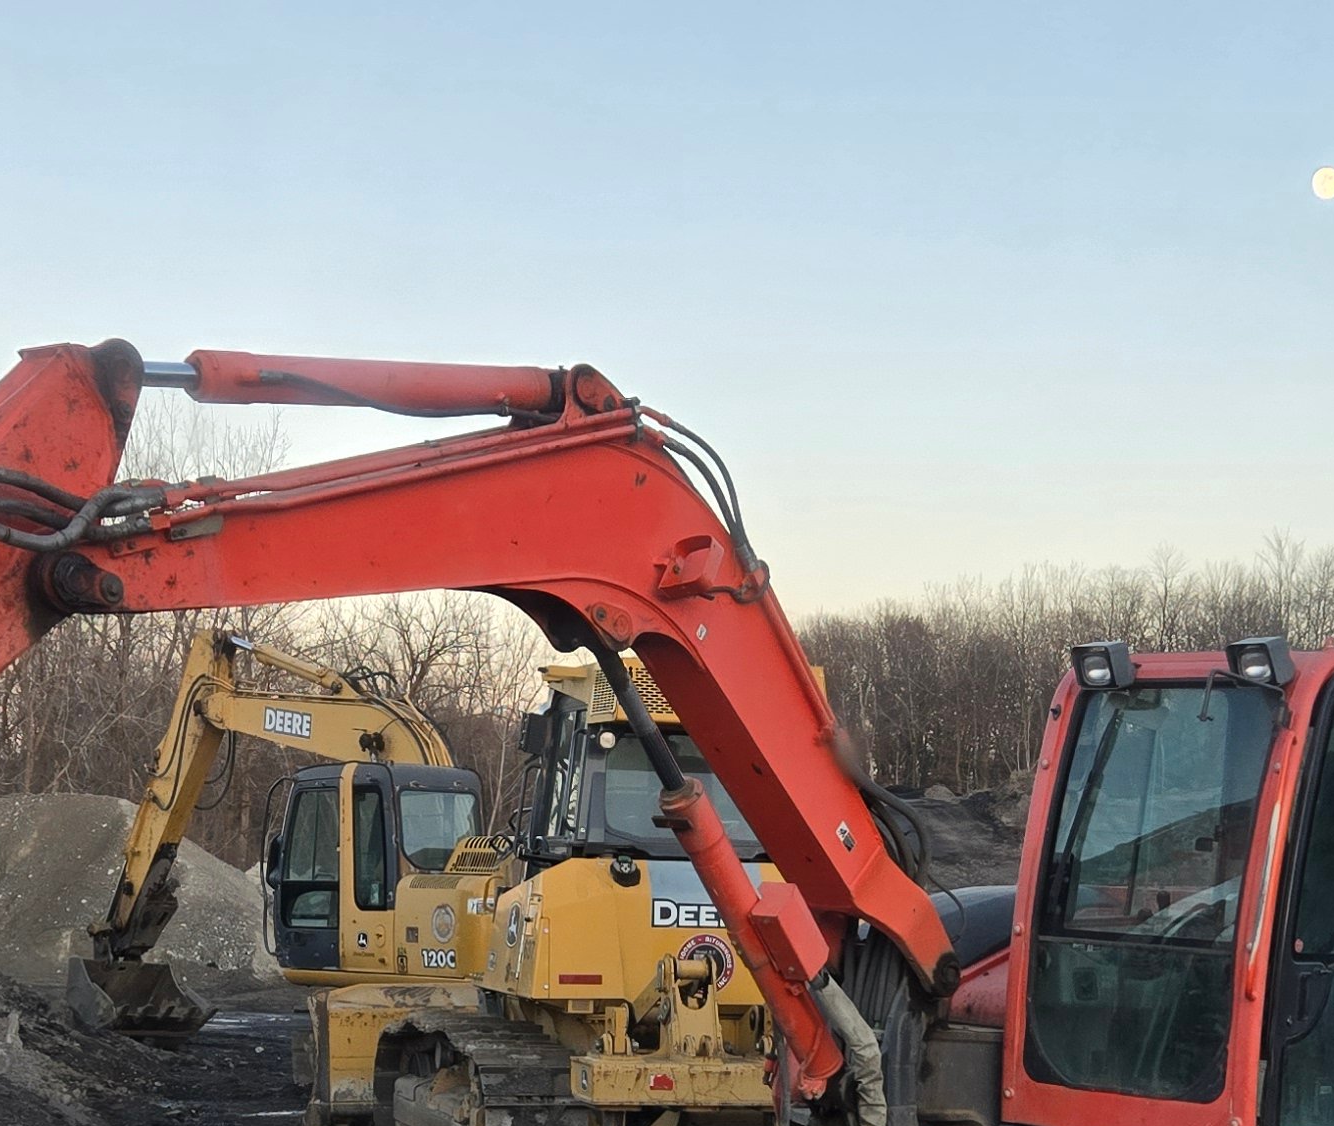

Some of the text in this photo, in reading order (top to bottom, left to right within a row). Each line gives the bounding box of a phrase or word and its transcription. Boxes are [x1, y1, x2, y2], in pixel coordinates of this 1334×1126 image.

[265, 708, 311, 737] DEERE
[653, 900, 725, 927] DEE
[422, 950, 456, 969] 120C
